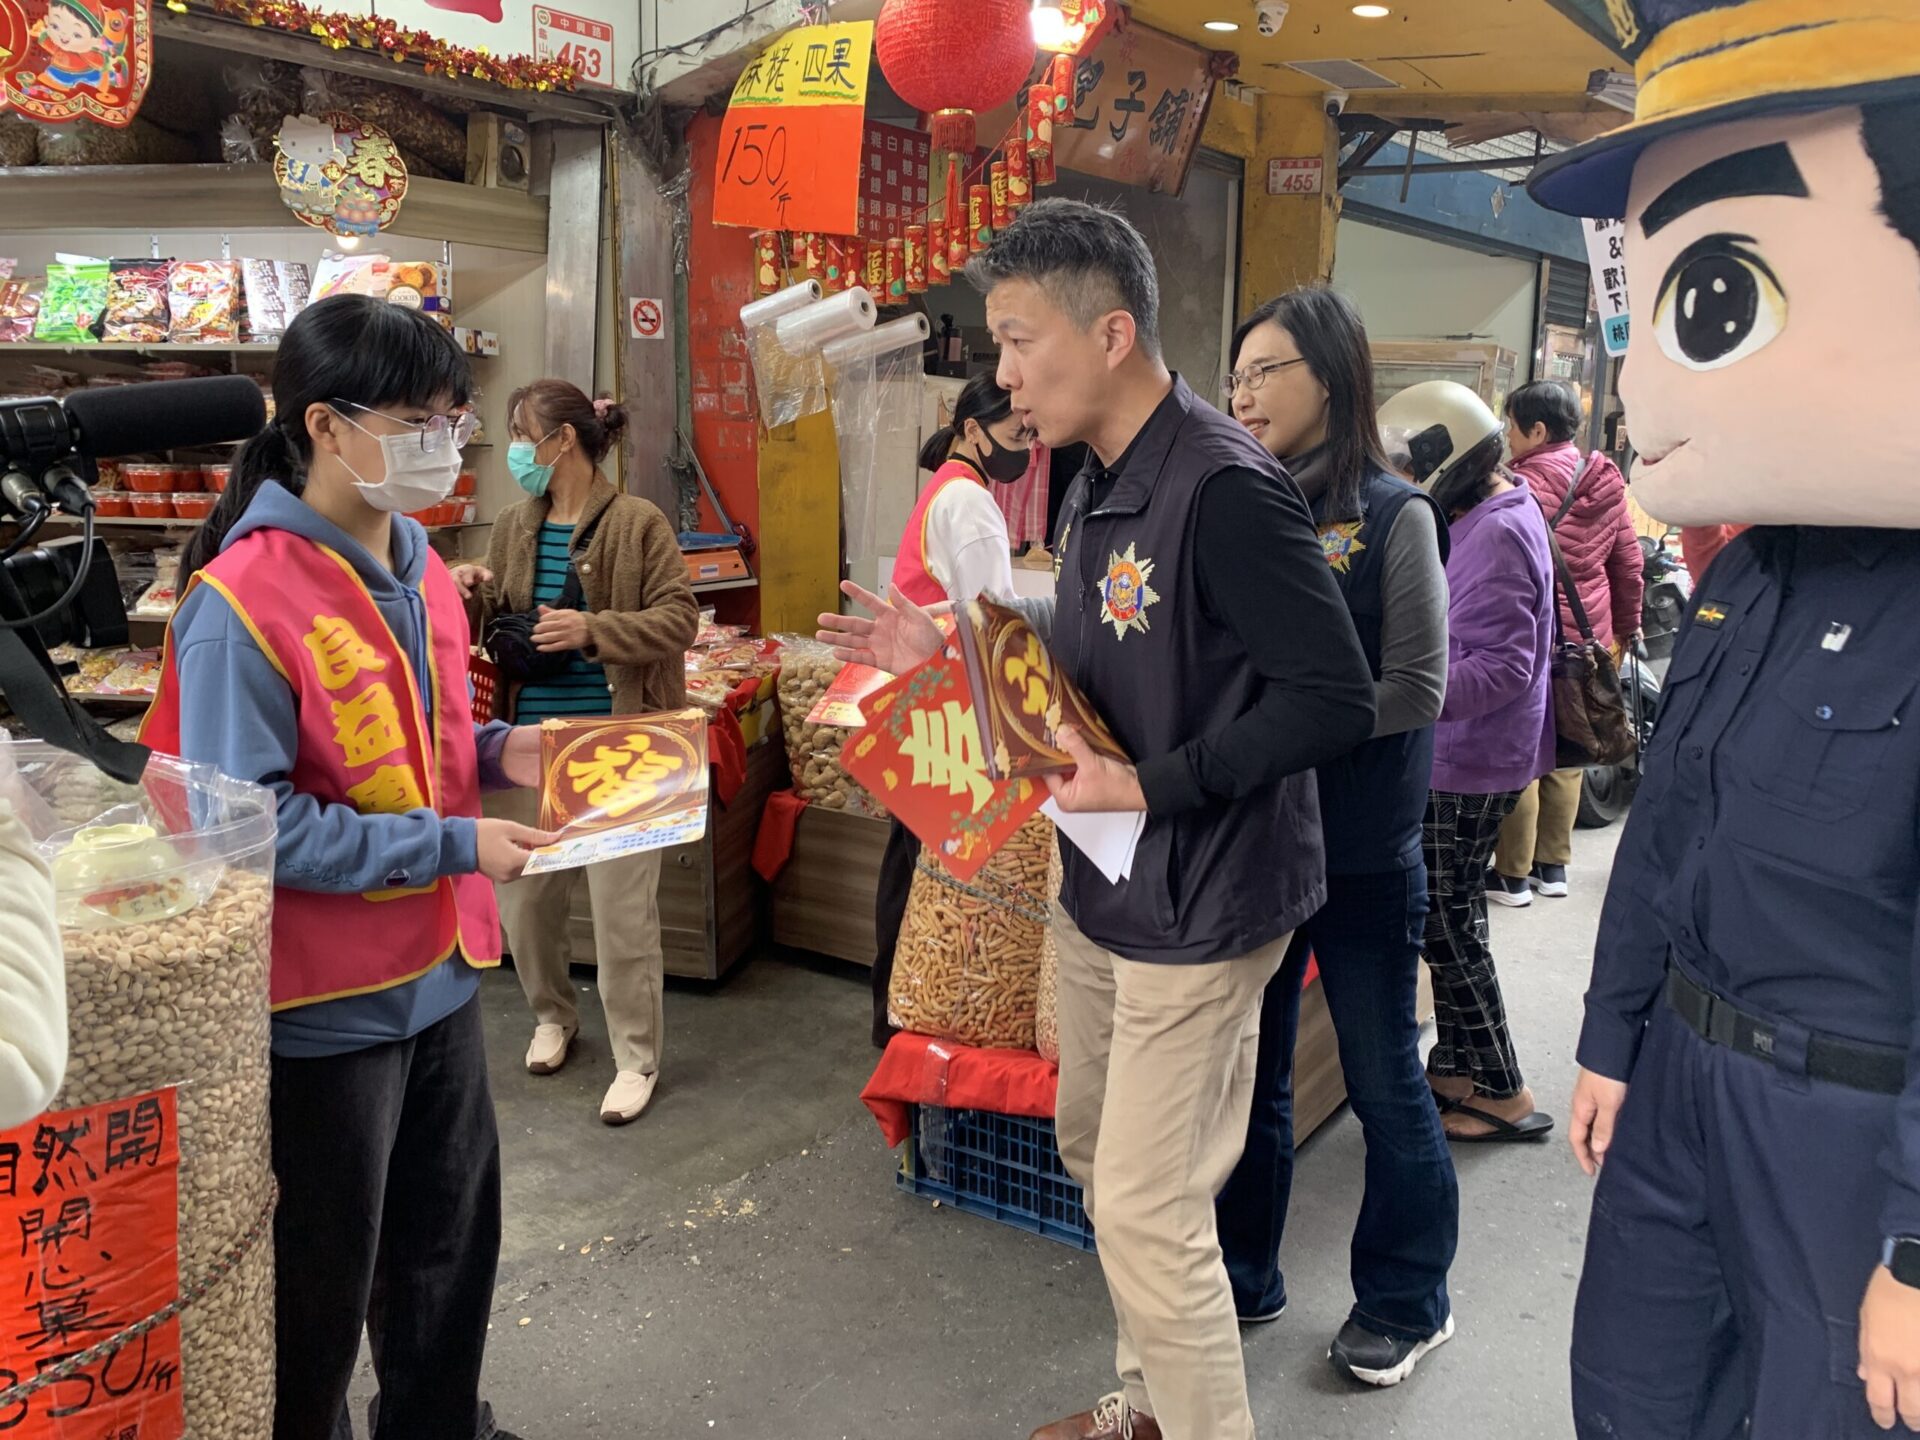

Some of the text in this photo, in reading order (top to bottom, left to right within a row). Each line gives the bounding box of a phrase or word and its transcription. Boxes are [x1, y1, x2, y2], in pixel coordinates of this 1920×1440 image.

[556, 42, 602, 79] 453
[346, 134, 405, 189] 春
[1283, 174, 1314, 192] 455
[1603, 266, 1627, 291] 歡
[567, 733, 684, 818] 福
